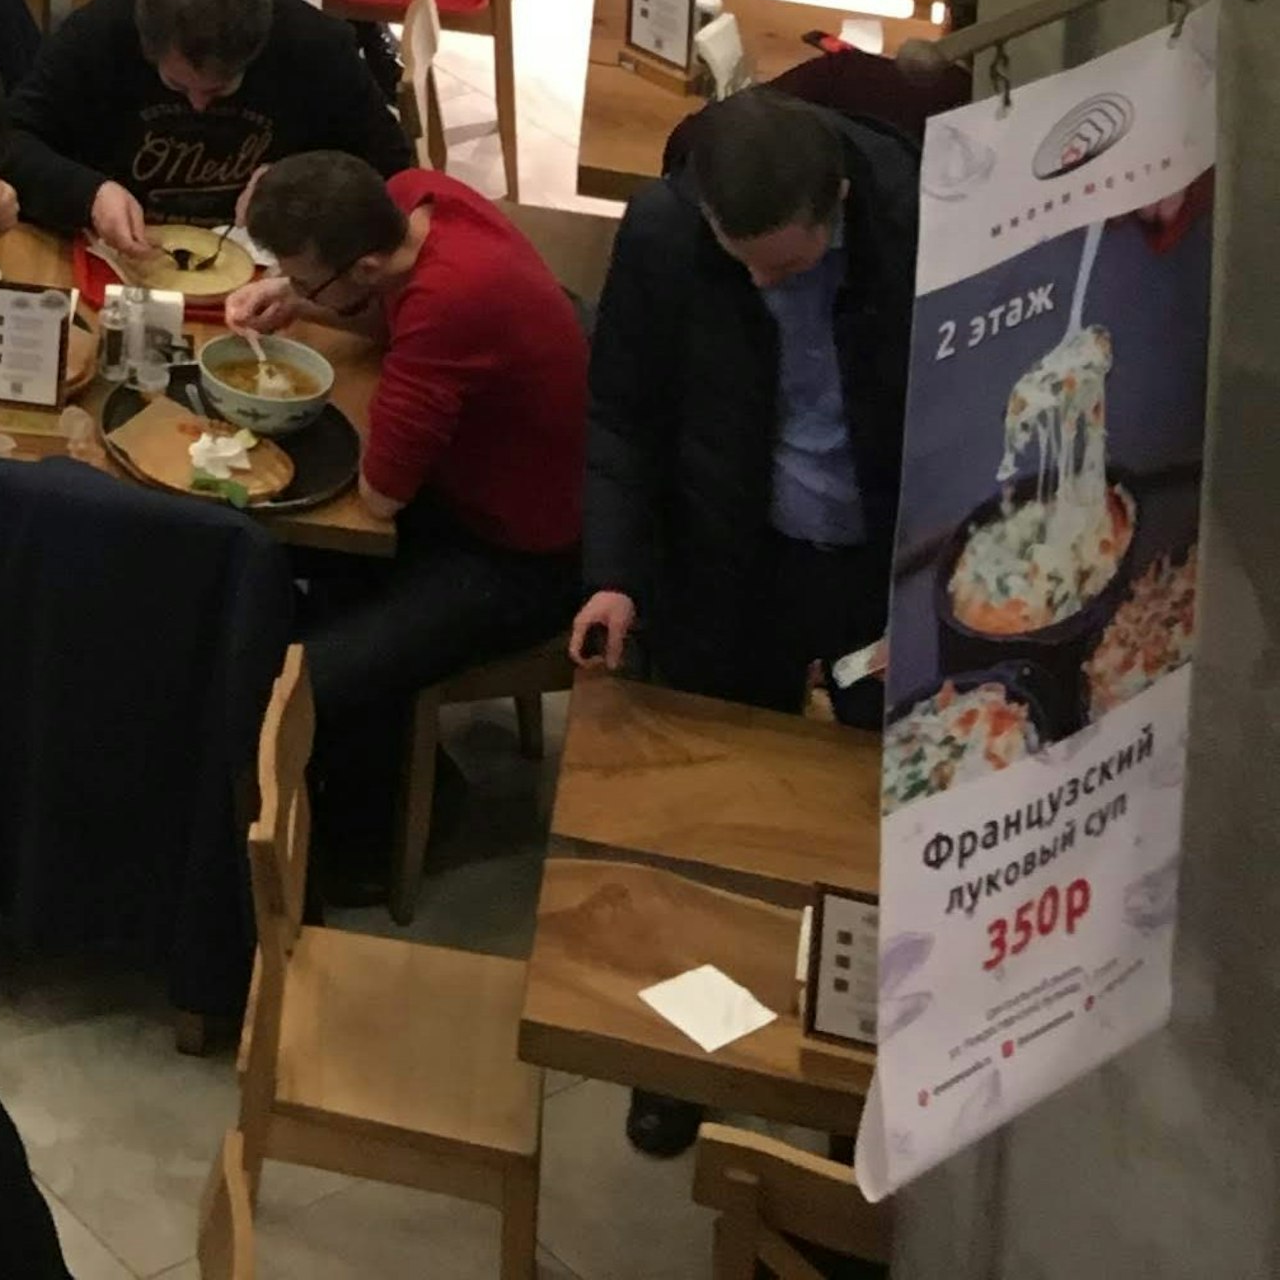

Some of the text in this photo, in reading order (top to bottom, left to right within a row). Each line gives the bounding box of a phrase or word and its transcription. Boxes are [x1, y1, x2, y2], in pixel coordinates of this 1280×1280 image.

[936, 283, 1054, 361] 2 этаж
[923, 722, 1154, 870] Французский
[945, 793, 1128, 918] луковый суп
